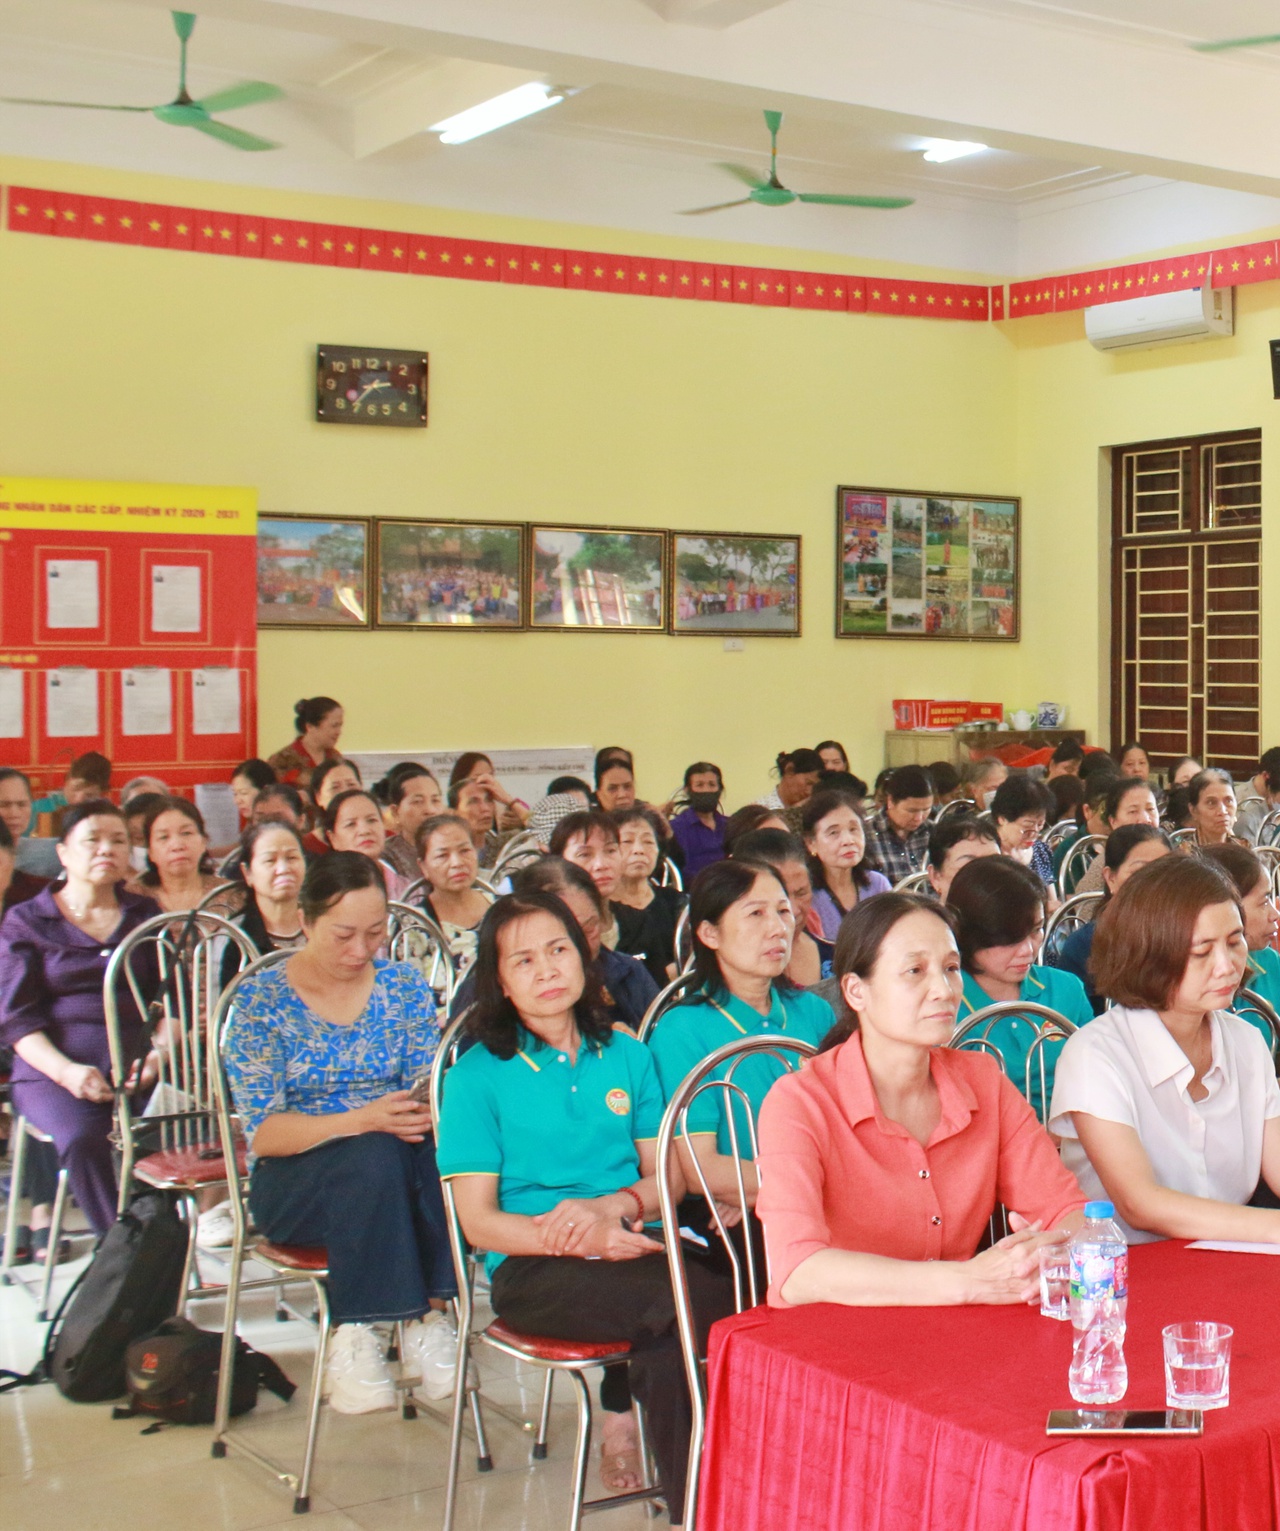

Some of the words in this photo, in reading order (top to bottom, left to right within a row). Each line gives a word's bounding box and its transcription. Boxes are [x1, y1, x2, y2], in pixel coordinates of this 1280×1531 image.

[332, 361, 346, 373] 10
[351, 358, 361, 370] 11
[366, 358, 379, 370] 12
[385, 361, 392, 371] 1
[399, 364, 408, 376] 2
[326, 378, 336, 390] 9
[407, 384, 417, 395] 3
[335, 397, 346, 409] 8
[398, 402, 407, 412] 4
[367, 404, 377, 415] 6
[381, 404, 391, 415] 5
[15, 501, 45, 512] NHÂN
[49, 502, 71, 513] DÂN
[75, 503, 96, 514] CÁC
[127, 505, 161, 517] NHIỆM
[165, 507, 177, 517] KỲ
[182, 508, 205, 518] 2026
[216, 510, 239, 519] 2031
